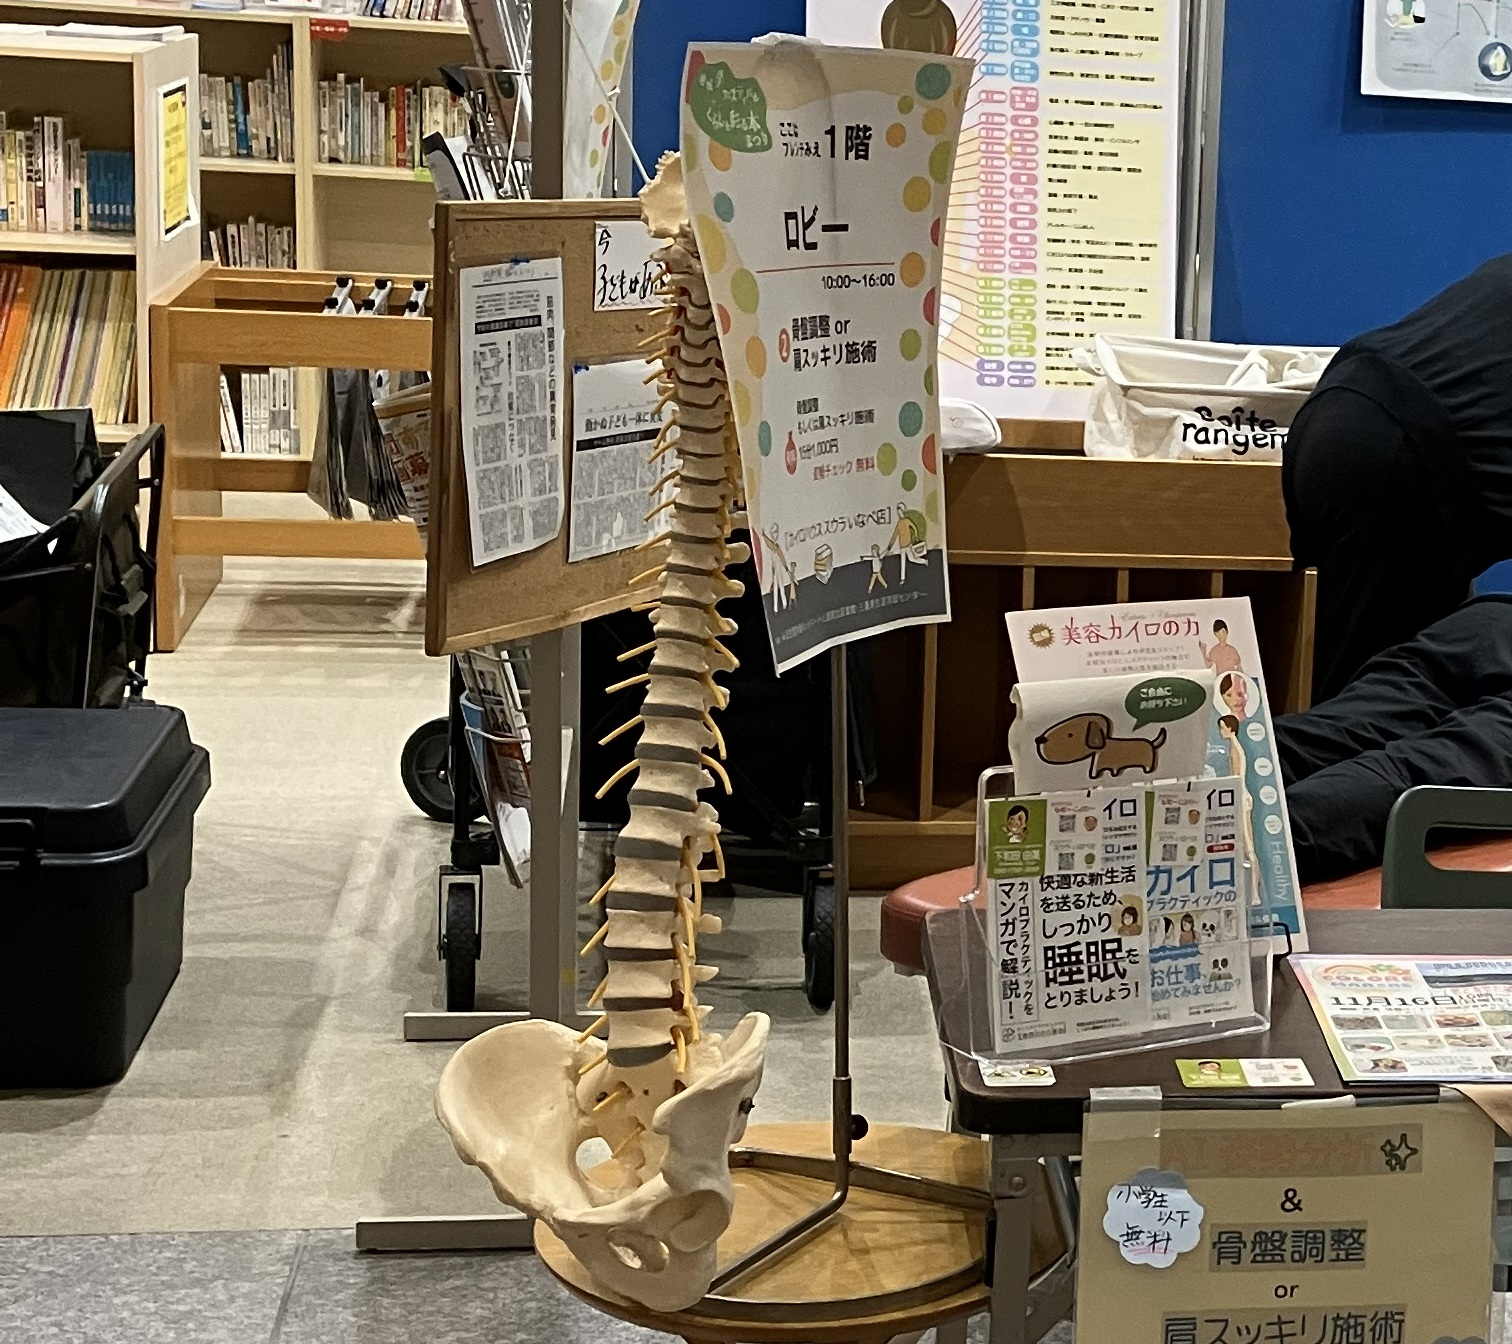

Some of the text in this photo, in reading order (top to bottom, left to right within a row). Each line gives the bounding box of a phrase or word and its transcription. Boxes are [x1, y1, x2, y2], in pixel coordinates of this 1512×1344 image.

[825, 124, 872, 161] 1階
[784, 205, 849, 250] ロビー
[834, 319, 851, 336] or
[793, 340, 877, 373] 肩スッキリ施術
[1062, 614, 1200, 646] 美容カイロの力
[1039, 865, 1137, 893] 快適な新生活
[1147, 857, 1235, 897] カイロ
[1040, 889, 1123, 913] を送るため、
[1042, 912, 1112, 939] しっかり
[1043, 937, 1140, 988] 睡眠を
[1044, 981, 1140, 1009] とりましょう!
[1280, 1187, 1303, 1213] &
[1119, 1223, 1172, 1254] 無料
[1211, 1227, 1367, 1268] 骨盤調整
[1273, 1283, 1299, 1300] or
